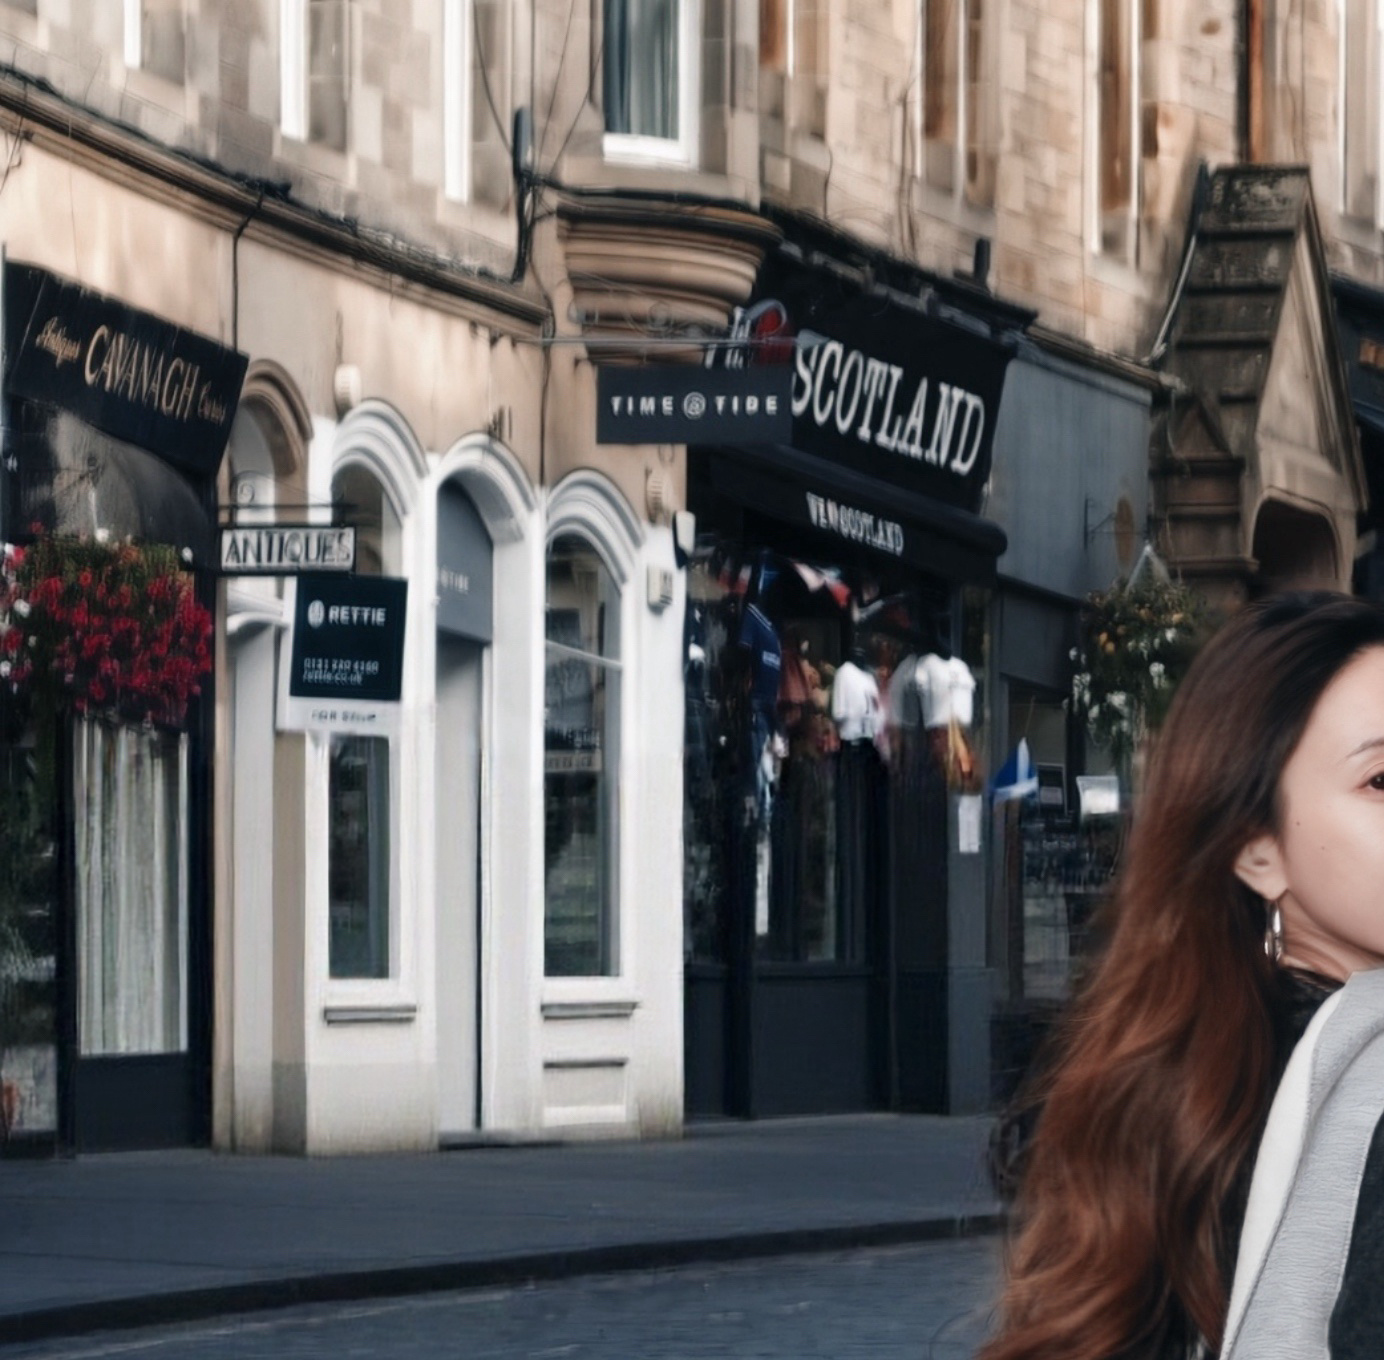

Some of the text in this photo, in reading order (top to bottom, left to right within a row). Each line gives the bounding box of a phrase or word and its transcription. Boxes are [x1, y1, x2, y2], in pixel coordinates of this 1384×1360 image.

[84, 324, 200, 424] CAVANAGH
[611, 395, 674, 417] TIME
[715, 395, 778, 417] TIDE
[791, 339, 986, 476] SCOTLAND
[225, 529, 351, 566] ANTIQUES
[329, 605, 387, 627] RETTIE
